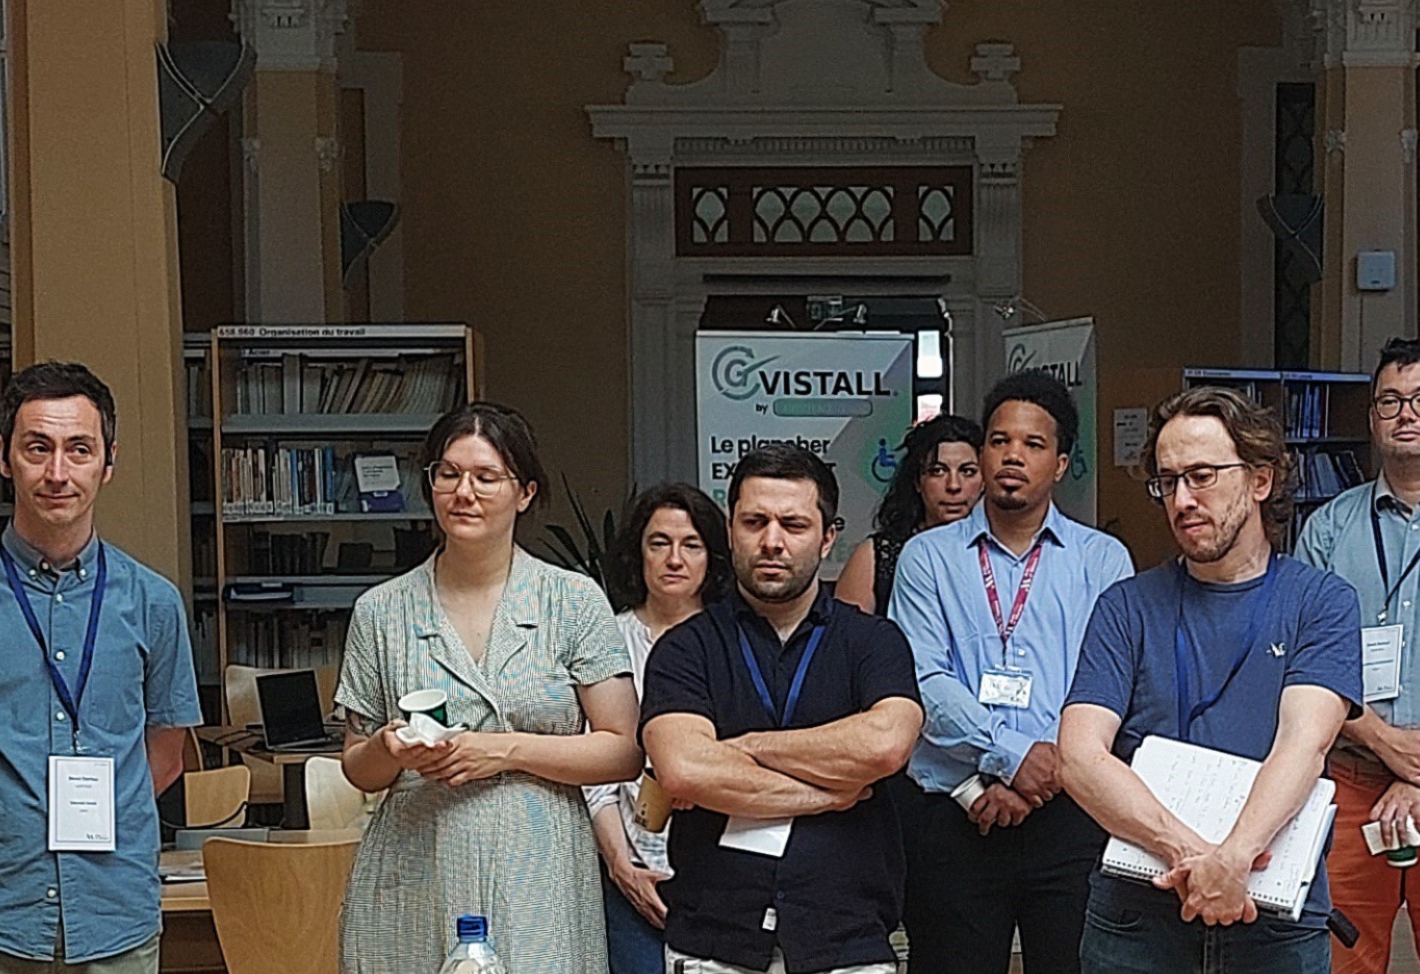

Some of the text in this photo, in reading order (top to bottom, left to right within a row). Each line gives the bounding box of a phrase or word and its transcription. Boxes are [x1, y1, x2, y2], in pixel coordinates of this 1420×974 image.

[258, 326, 320, 339] Organisation
[336, 326, 366, 337] travail
[759, 370, 891, 396] VISTALL
[755, 404, 768, 415] by
[710, 435, 734, 454] Le
